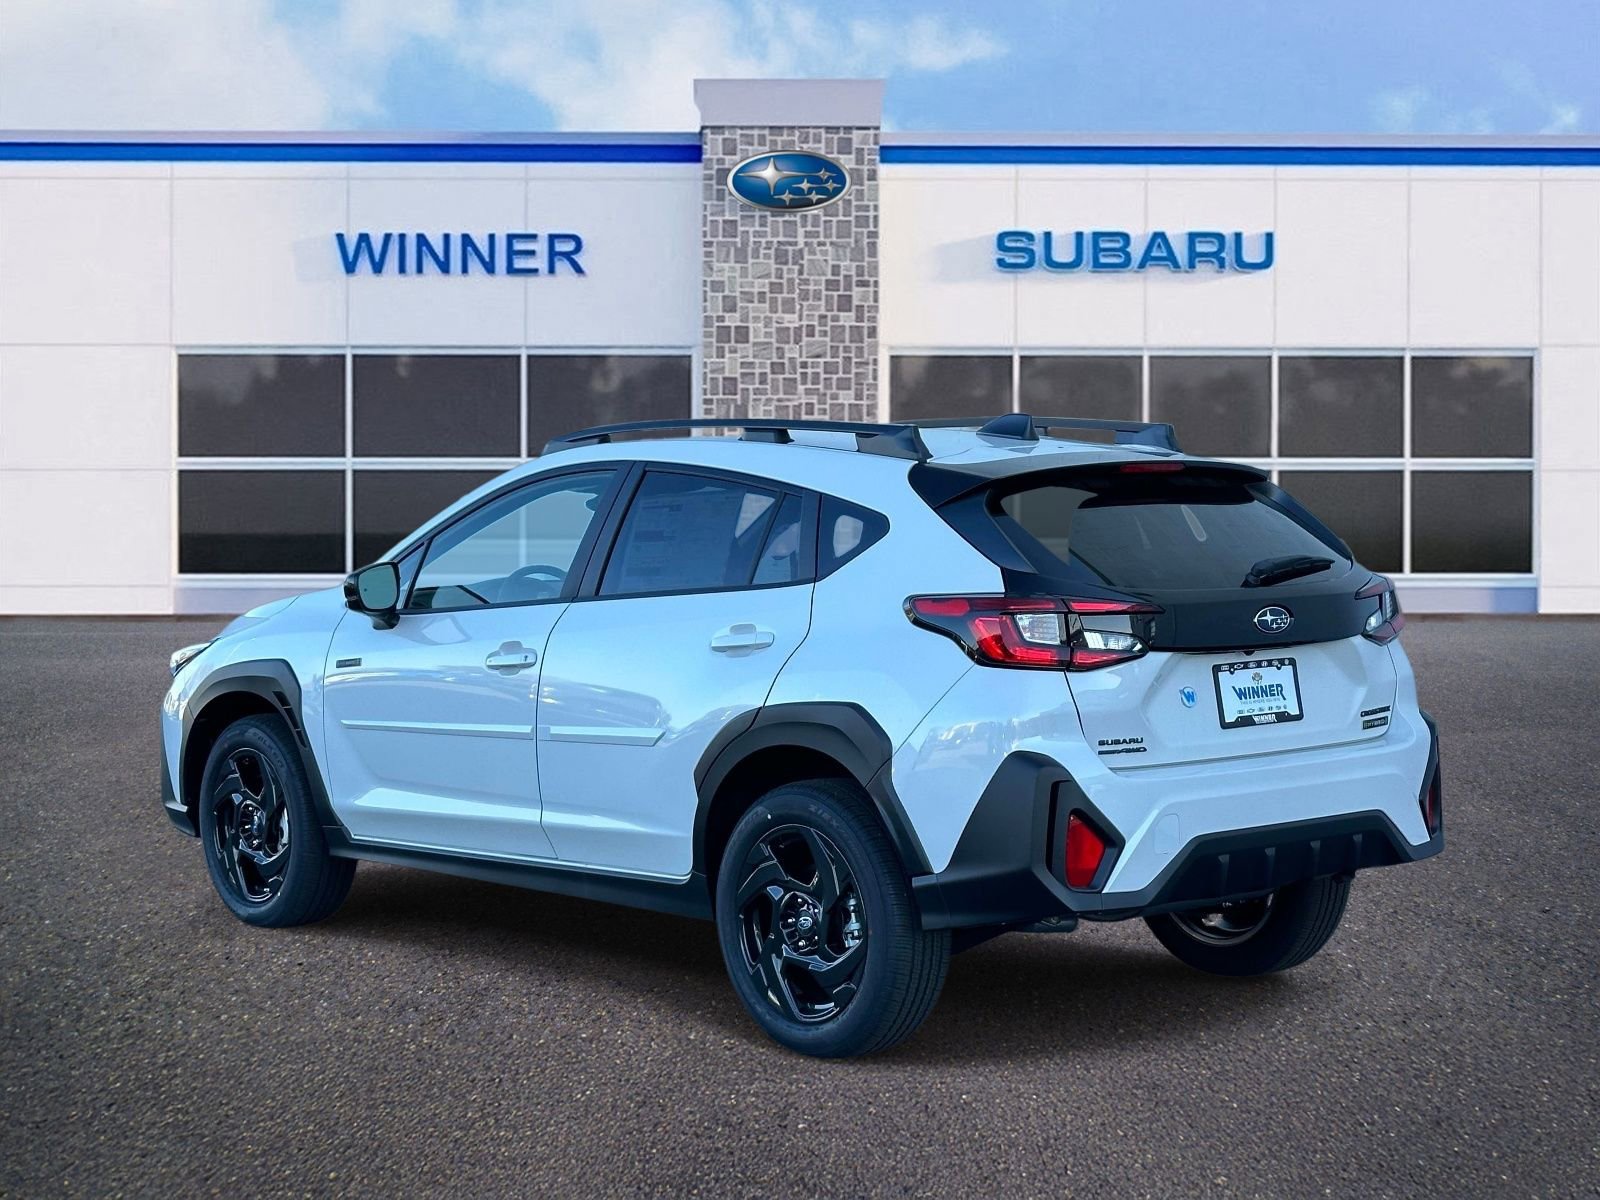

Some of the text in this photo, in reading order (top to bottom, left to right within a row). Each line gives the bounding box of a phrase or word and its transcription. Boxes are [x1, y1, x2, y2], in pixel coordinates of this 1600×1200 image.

[335, 232, 586, 275] WINNER
[995, 230, 1275, 272] SUBARU
[1231, 683, 1287, 701] WINNER
[1097, 736, 1144, 746] SUBARU
